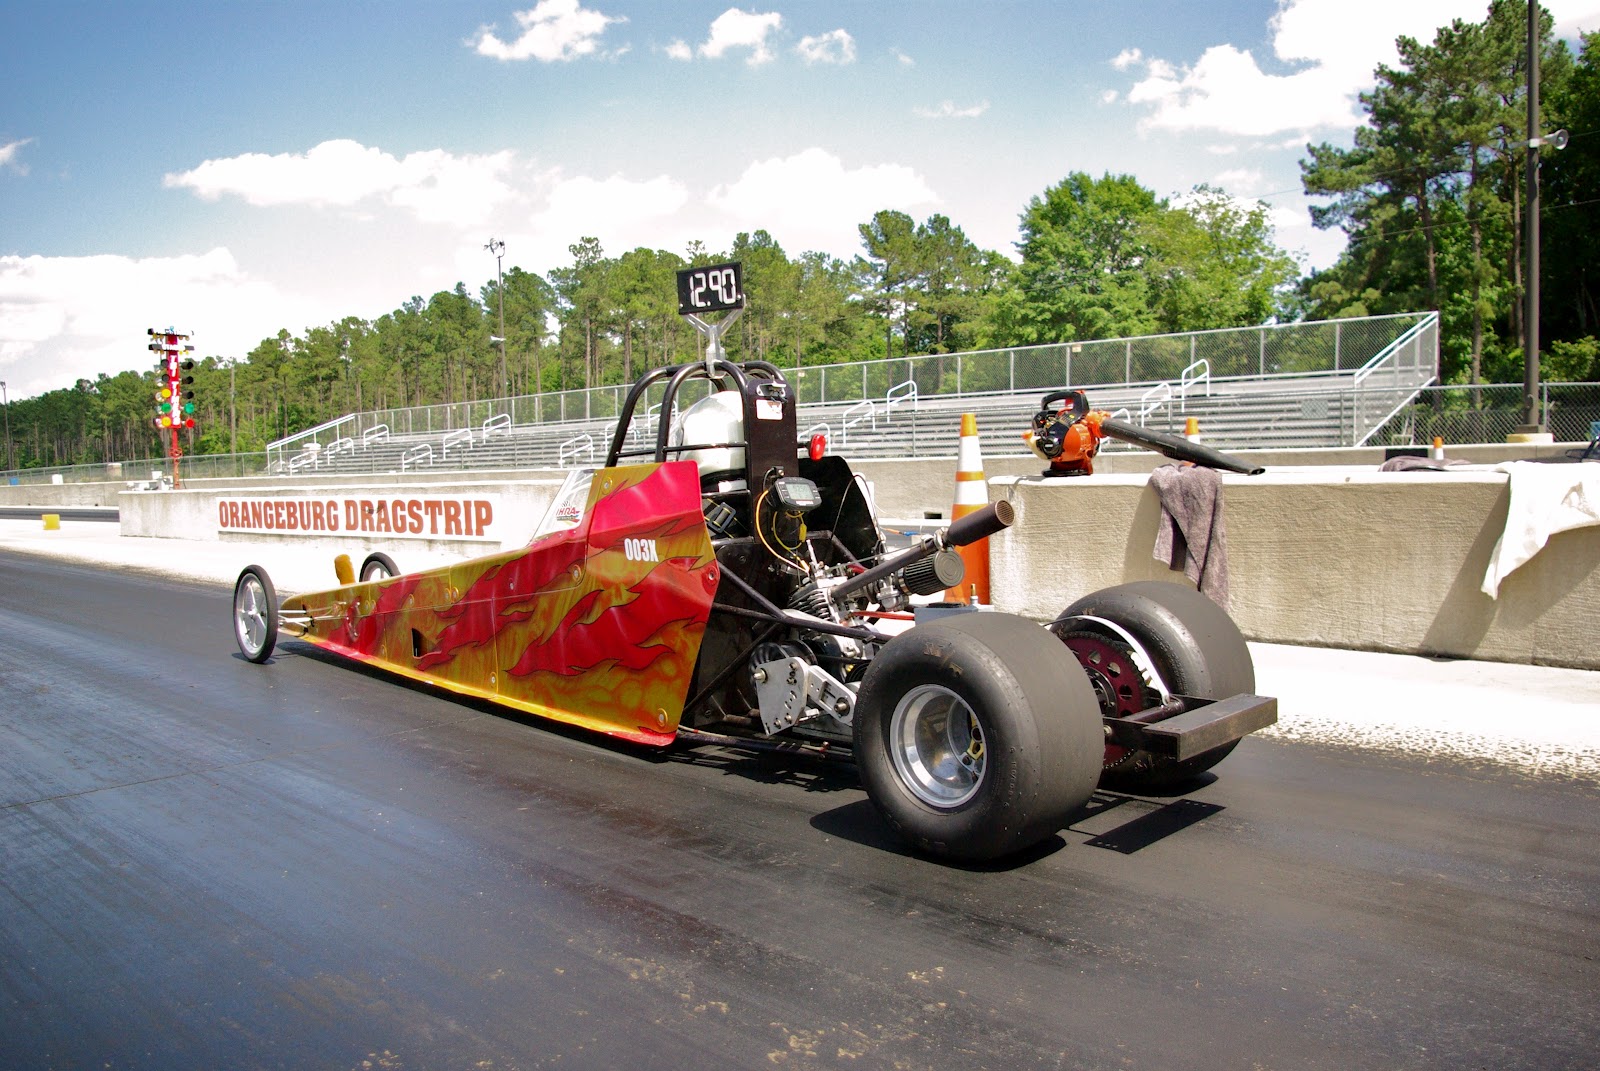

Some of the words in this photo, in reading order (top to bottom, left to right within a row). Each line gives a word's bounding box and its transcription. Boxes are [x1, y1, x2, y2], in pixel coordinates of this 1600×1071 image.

[218, 501, 339, 531] ORANGEBURG
[344, 499, 493, 537] DRAGSTRIP
[555, 507, 576, 516] IHRA
[623, 537, 660, 563] 003X
